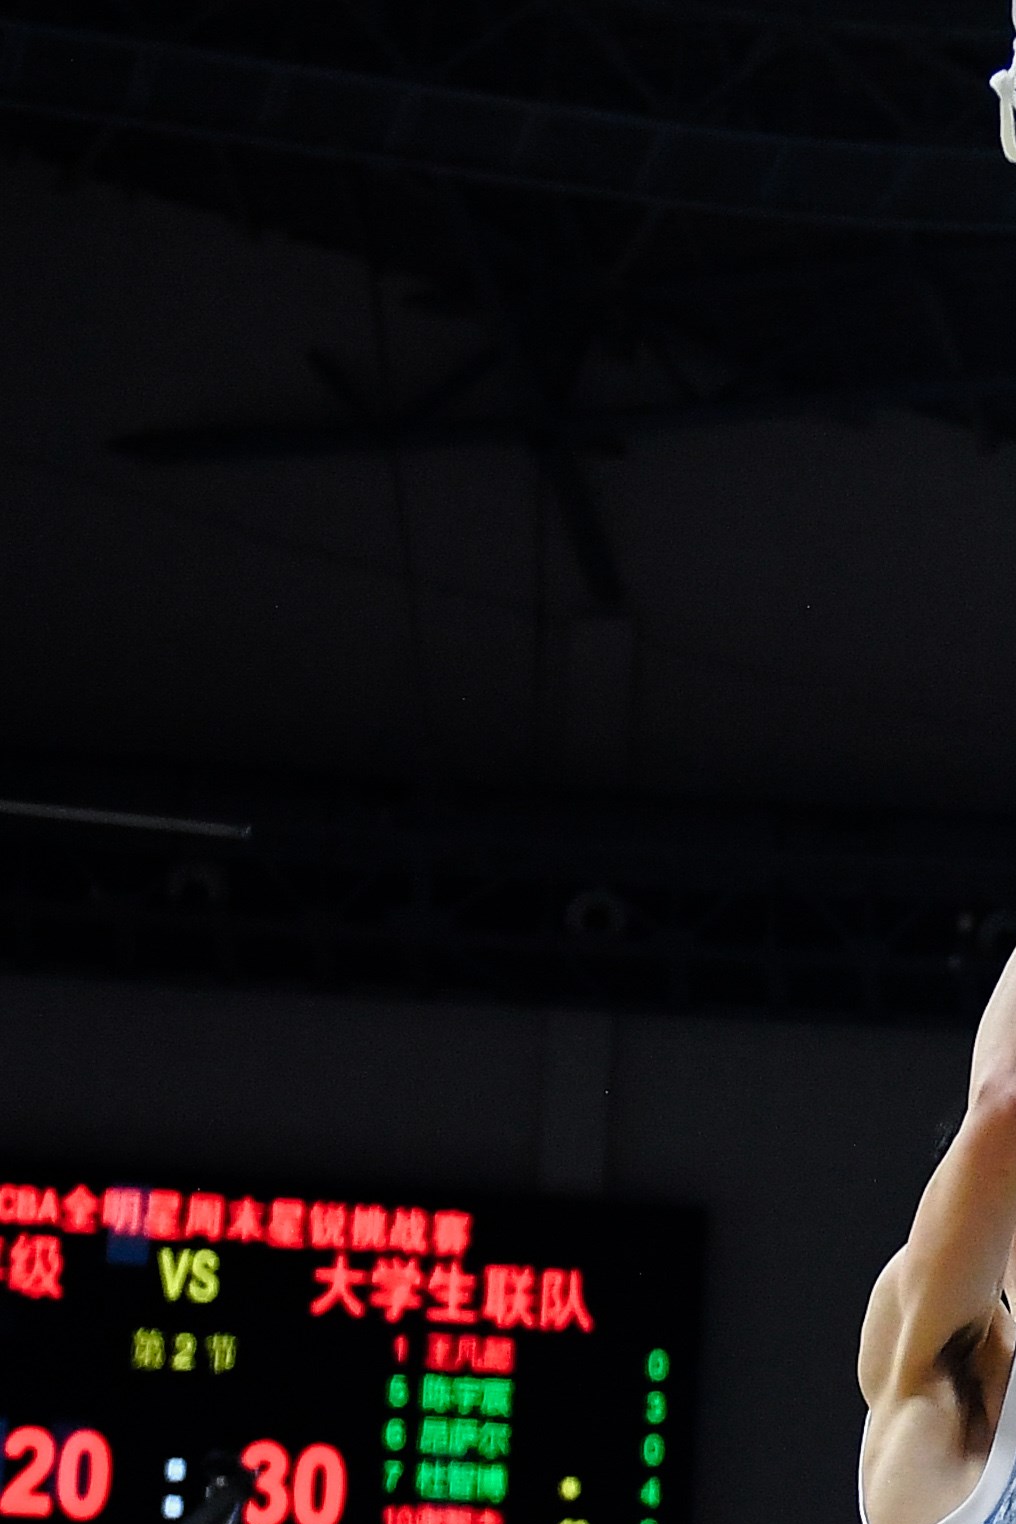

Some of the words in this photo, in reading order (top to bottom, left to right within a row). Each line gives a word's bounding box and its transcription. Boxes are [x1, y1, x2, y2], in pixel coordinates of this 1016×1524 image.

[158, 1247, 220, 1303] VS
[310, 1255, 594, 1334] 大学生联队
[0, 1424, 113, 1521] 20
